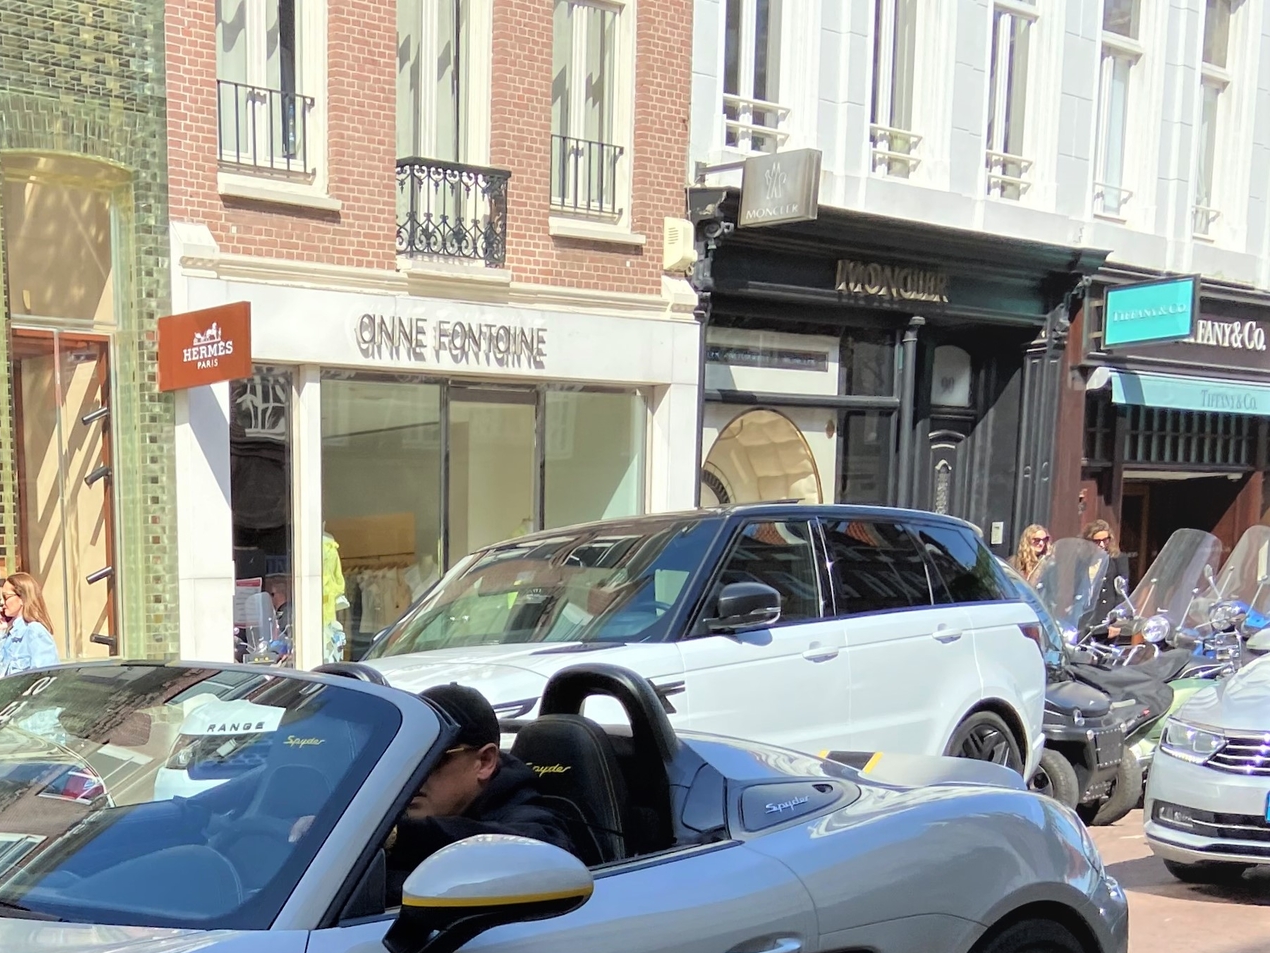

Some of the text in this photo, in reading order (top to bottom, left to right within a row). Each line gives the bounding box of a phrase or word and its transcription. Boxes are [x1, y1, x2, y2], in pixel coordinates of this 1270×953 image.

[745, 203, 799, 220] MONCLER
[835, 259, 949, 303] MONCLER
[197, 358, 219, 370] PARIS
[207, 721, 266, 733] RANGE
[283, 735, 326, 749] Spyder
[765, 795, 811, 815] Spyder
